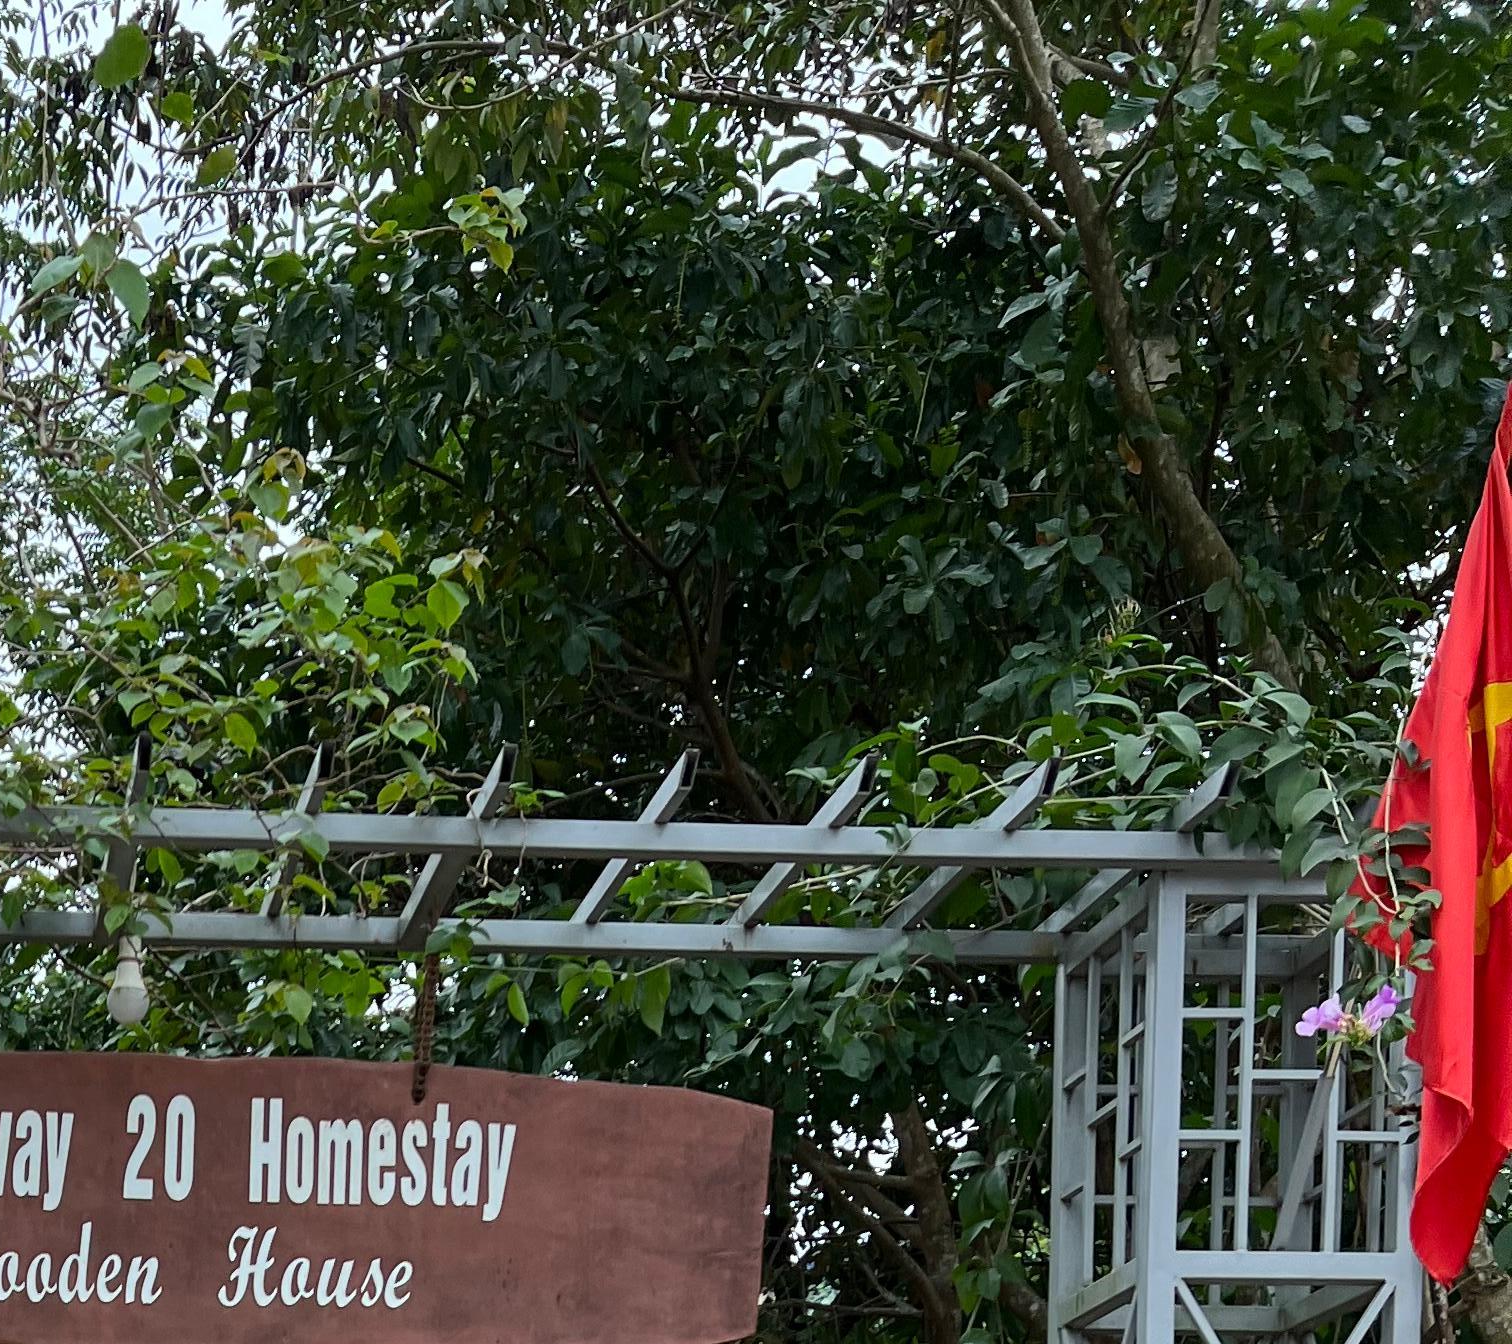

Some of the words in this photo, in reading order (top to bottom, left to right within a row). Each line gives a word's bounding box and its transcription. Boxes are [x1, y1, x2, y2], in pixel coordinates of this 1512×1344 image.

[123, 1095, 195, 1201] 20
[249, 1098, 516, 1221] Homestay
[218, 1226, 412, 1308] House
